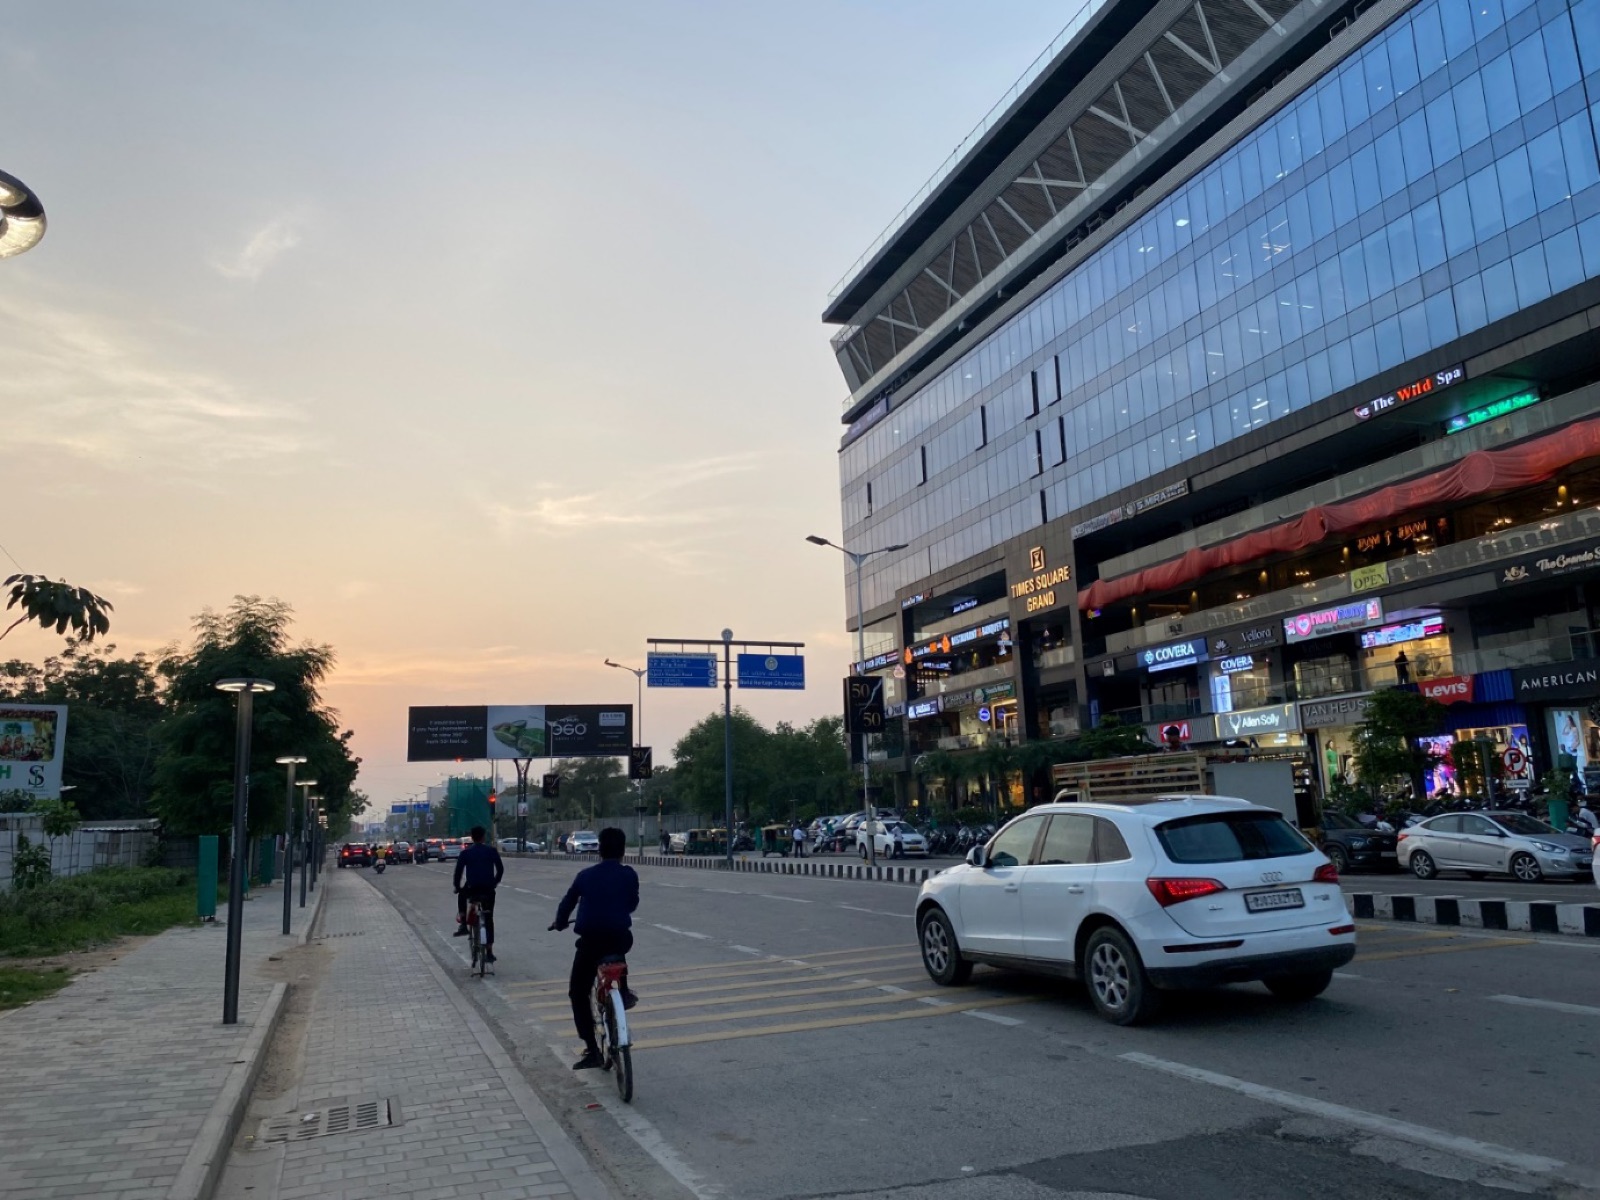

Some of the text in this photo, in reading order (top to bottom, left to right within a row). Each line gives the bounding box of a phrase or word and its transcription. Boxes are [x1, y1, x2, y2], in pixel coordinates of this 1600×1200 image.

[1371, 368, 1461, 411] The Wild Spa
[1011, 566, 1070, 598] TIMES SQUARE
[1353, 573, 1385, 589] OPEN
[1026, 591, 1055, 612] GRAND
[1155, 643, 1195, 661] COVERA
[1220, 655, 1254, 670] COVERA
[1521, 670, 1597, 690] AMERICAN
[851, 683, 870, 698] 50
[1306, 699, 1376, 717] VAN HEUSE
[863, 712, 881, 727] 50
